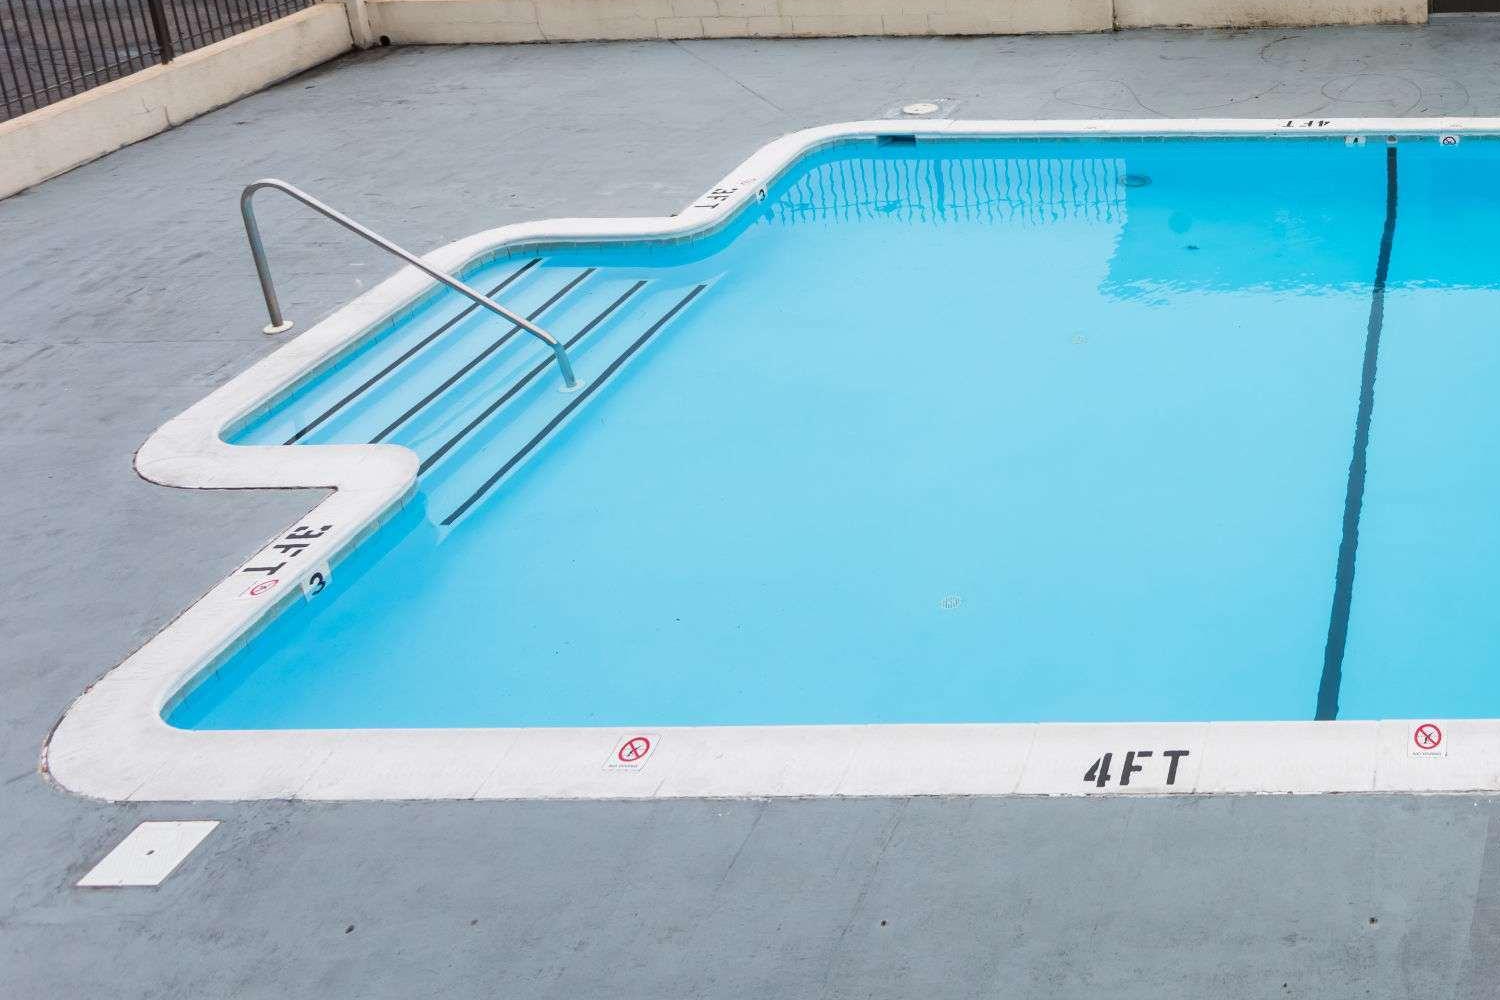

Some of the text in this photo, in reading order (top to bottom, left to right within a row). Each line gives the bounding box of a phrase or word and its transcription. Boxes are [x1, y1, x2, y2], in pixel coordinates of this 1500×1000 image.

[242, 524, 334, 576] 3FT
[308, 571, 327, 597] 3
[1083, 750, 1190, 788] 4FT
